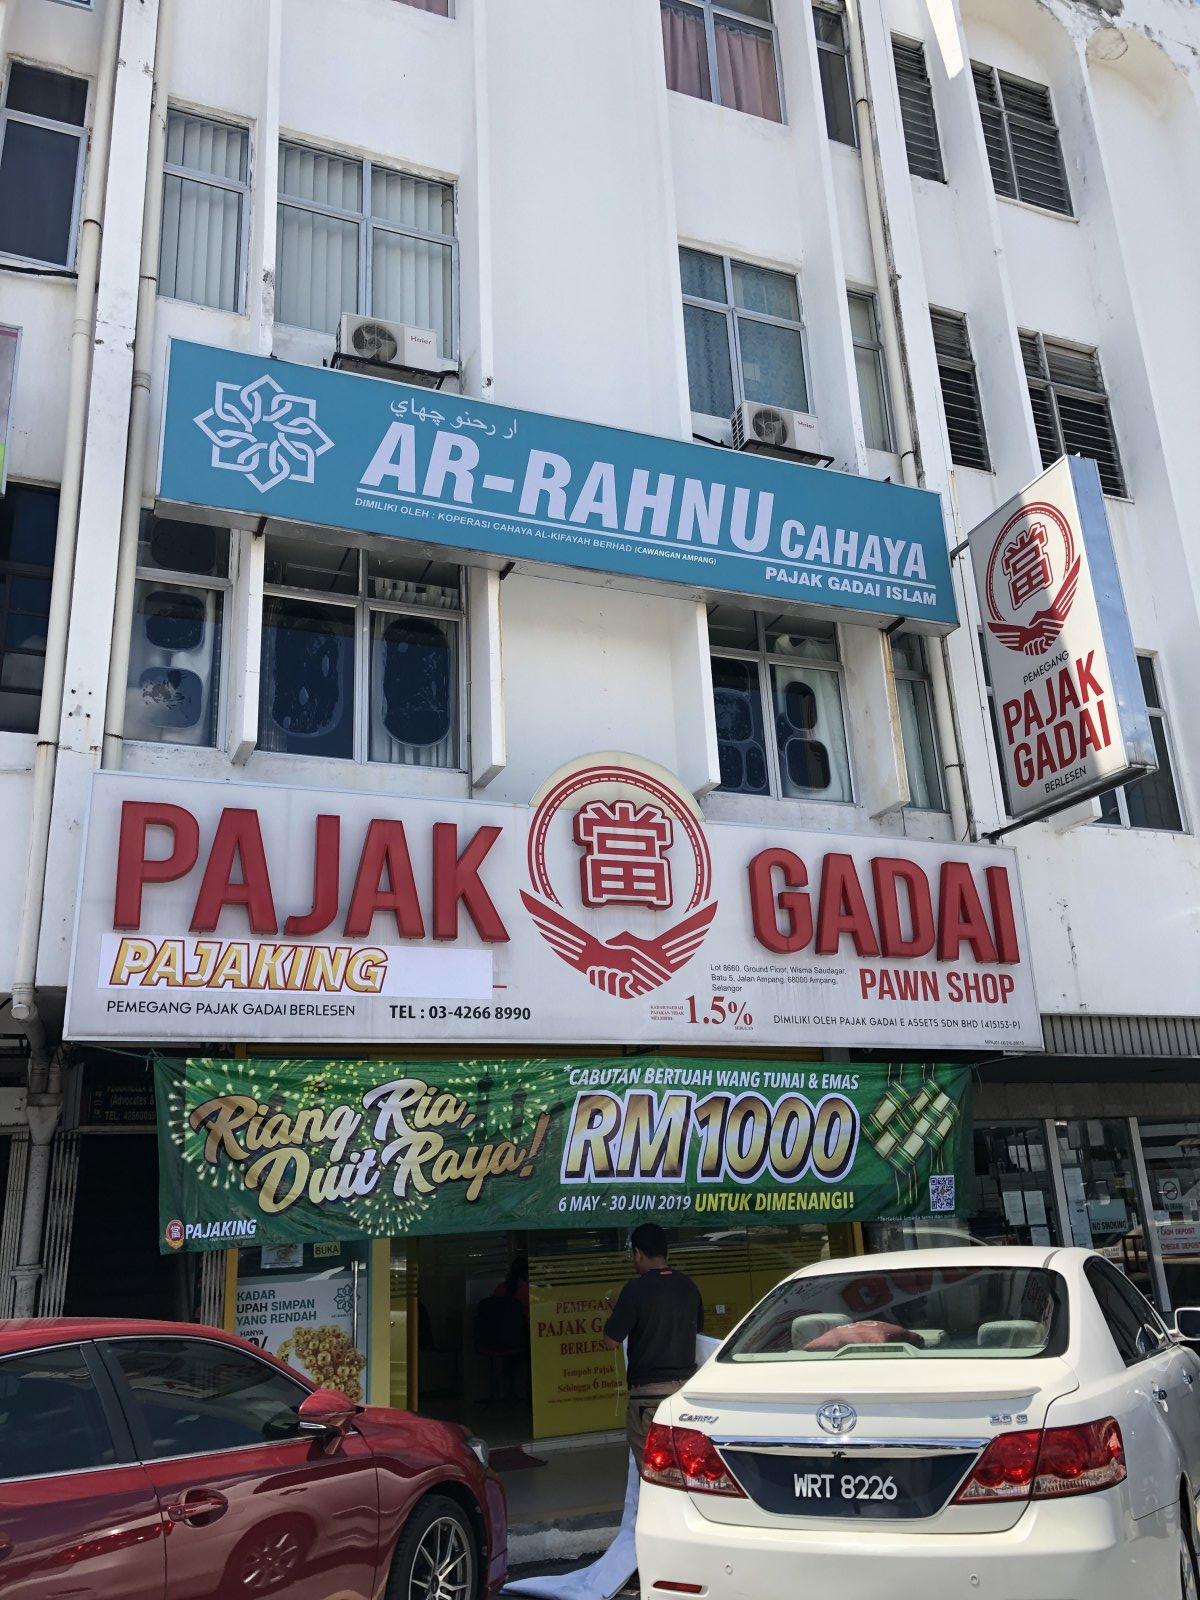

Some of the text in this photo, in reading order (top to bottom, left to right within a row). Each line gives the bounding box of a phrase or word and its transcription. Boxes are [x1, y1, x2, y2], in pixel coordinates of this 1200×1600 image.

[409, 335, 432, 345] Haier
[360, 421, 927, 580] AR-RAHNU CAHAYA
[355, 497, 398, 513] DIMILIKI
[400, 506, 429, 518] OLEH
[438, 512, 491, 528] KOPERASI
[493, 522, 533, 536] CAHAYA
[535, 530, 591, 546] AL-KIFAYAH
[593, 539, 632, 552] BERHAD
[634, 546, 681, 560] (CAWANGAN
[682, 553, 717, 566] AMPANG)
[765, 566, 937, 606] PAJAK GADAI ISLAM
[1023, 650, 1069, 685] PEMEGANG
[1002, 649, 1104, 745] PAJAK
[1013, 699, 1111, 788] GADAI
[1045, 765, 1087, 793] BERLESEN
[113, 799, 511, 943] PAJAK
[748, 847, 1021, 965] GADAI
[109, 937, 388, 993] PAJAKING
[710, 964, 721, 972] Lot
[743, 965, 768, 973] Ground
[790, 966, 812, 974] Wisma
[814, 966, 847, 976] Saudagar,
[711, 974, 726, 982] Batu
[737, 974, 756, 982] Jalan
[787, 976, 808, 984] 68000
[712, 984, 743, 993] Selangor
[859, 968, 1015, 1004] PAWN SHOP
[106, 1000, 356, 1016] PEMEGANG PAJAK GADAI BERLESEN
[390, 1004, 416, 1020] TEL
[429, 1005, 491, 1021] 03-4266
[495, 1005, 531, 1021] 8990
[685, 995, 753, 1026] 1.5%
[774, 1014, 810, 1024] DIMILIKI
[813, 1016, 837, 1025] OLEH
[840, 1016, 867, 1026] PAJAK
[870, 1017, 898, 1026] GADAI
[900, 1018, 906, 1027] E
[908, 1018, 938, 1028] ASSETS
[941, 1019, 958, 1028] SDN
[962, 1020, 978, 1028] BHD
[644, 1068, 713, 1086] BERTUAH
[716, 1070, 760, 1088] WANG
[763, 1072, 805, 1088] TUNAI
[808, 1073, 818, 1088] &
[822, 1073, 860, 1090] EMAS
[189, 1077, 478, 1165] Riang Ria,
[560, 1089, 860, 1184] RM1000
[243, 1111, 552, 1214] Duit Raya!
[558, 1196, 567, 1211] 6
[571, 1196, 600, 1211] MAY
[609, 1196, 626, 1211] 30
[628, 1195, 658, 1212] JUN
[660, 1195, 691, 1211] 2019
[694, 1193, 752, 1212] UNTUK
[756, 1192, 854, 1211] DIMENANGI!
[185, 1219, 257, 1240] PAJAKING
[1092, 1220, 1127, 1230] NO SMOKING
[315, 1244, 339, 1255] BUKA
[237, 1290, 276, 1301] KADAR
[236, 1299, 315, 1314] UPAH SIMPAN
[556, 1300, 613, 1314] PEMEGAN
[236, 1315, 267, 1326] YANG
[270, 1311, 316, 1324] RENDAH
[537, 1318, 586, 1338] PAJAK
[563, 1366, 615, 1378] Tempoh Pajak
[558, 1382, 591, 1393] Sehingga
[593, 1378, 599, 1390] 6
[794, 1473, 898, 1500] WRT 8226
